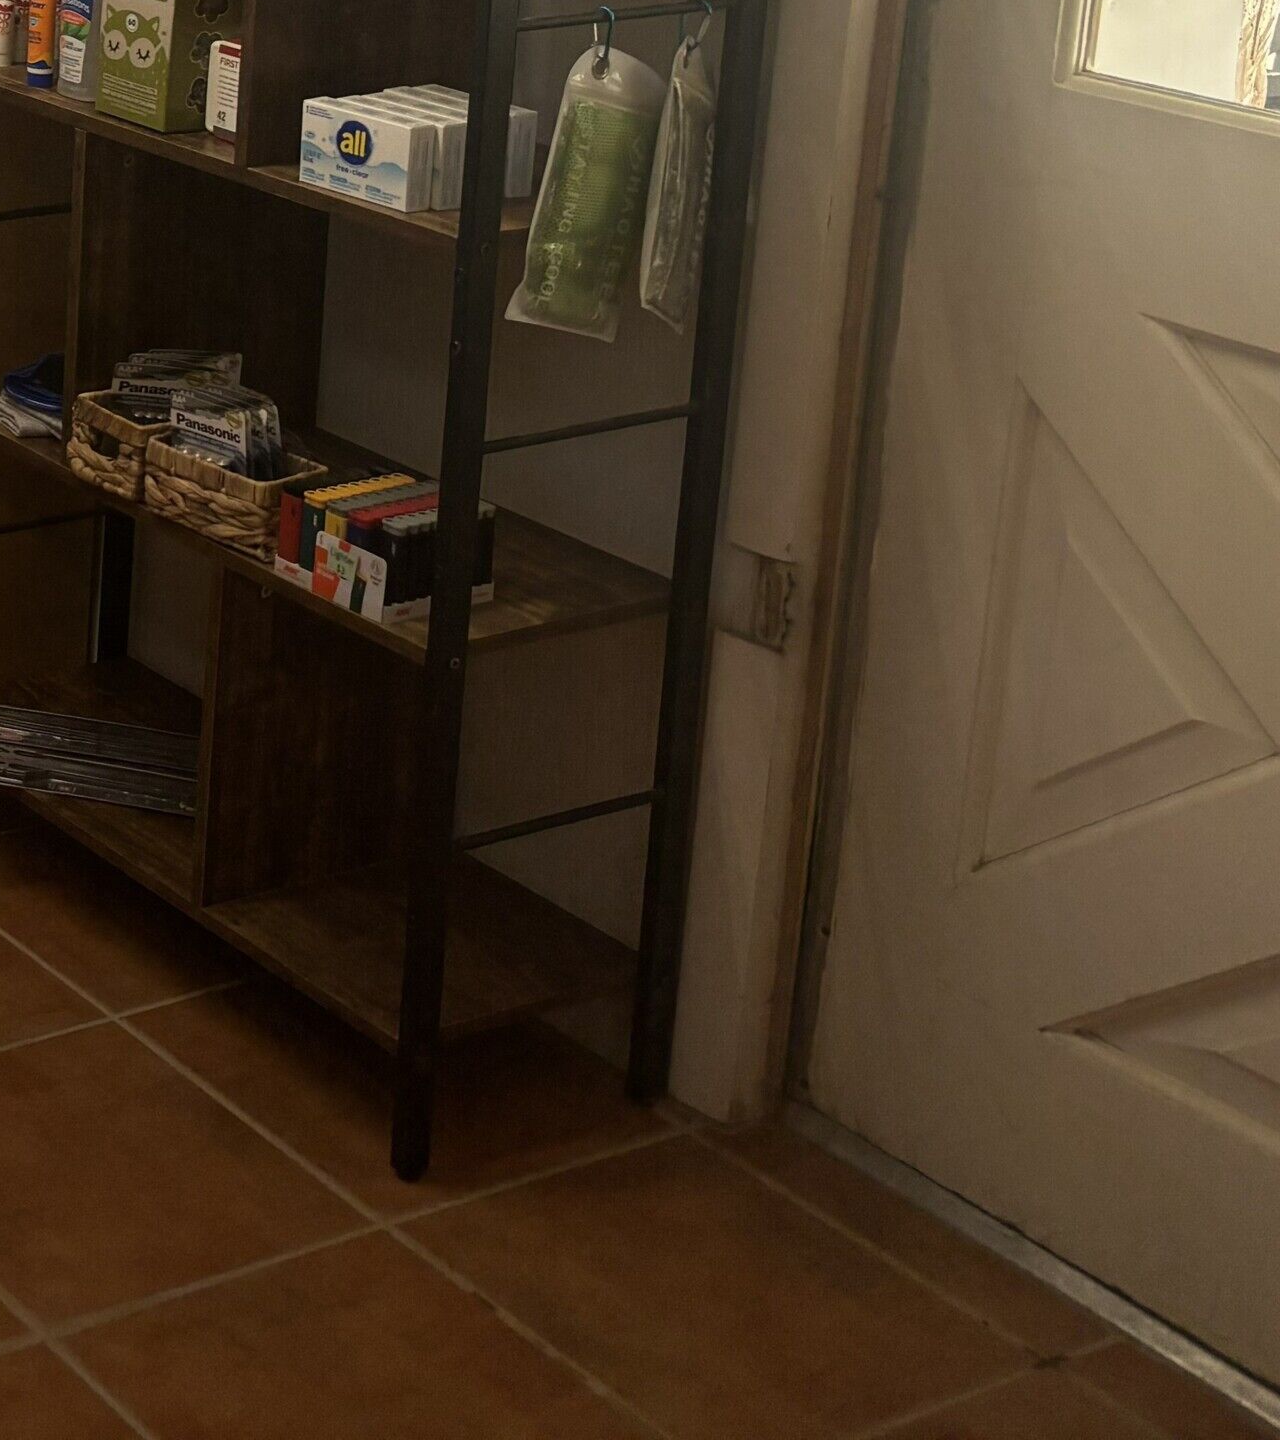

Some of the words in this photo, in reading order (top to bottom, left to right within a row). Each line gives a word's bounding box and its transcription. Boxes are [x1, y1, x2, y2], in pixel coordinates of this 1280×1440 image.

[219, 56, 239, 68] FIRST
[216, 110, 226, 122] 42
[340, 130, 366, 157] all
[176, 412, 241, 444] Panasonic
